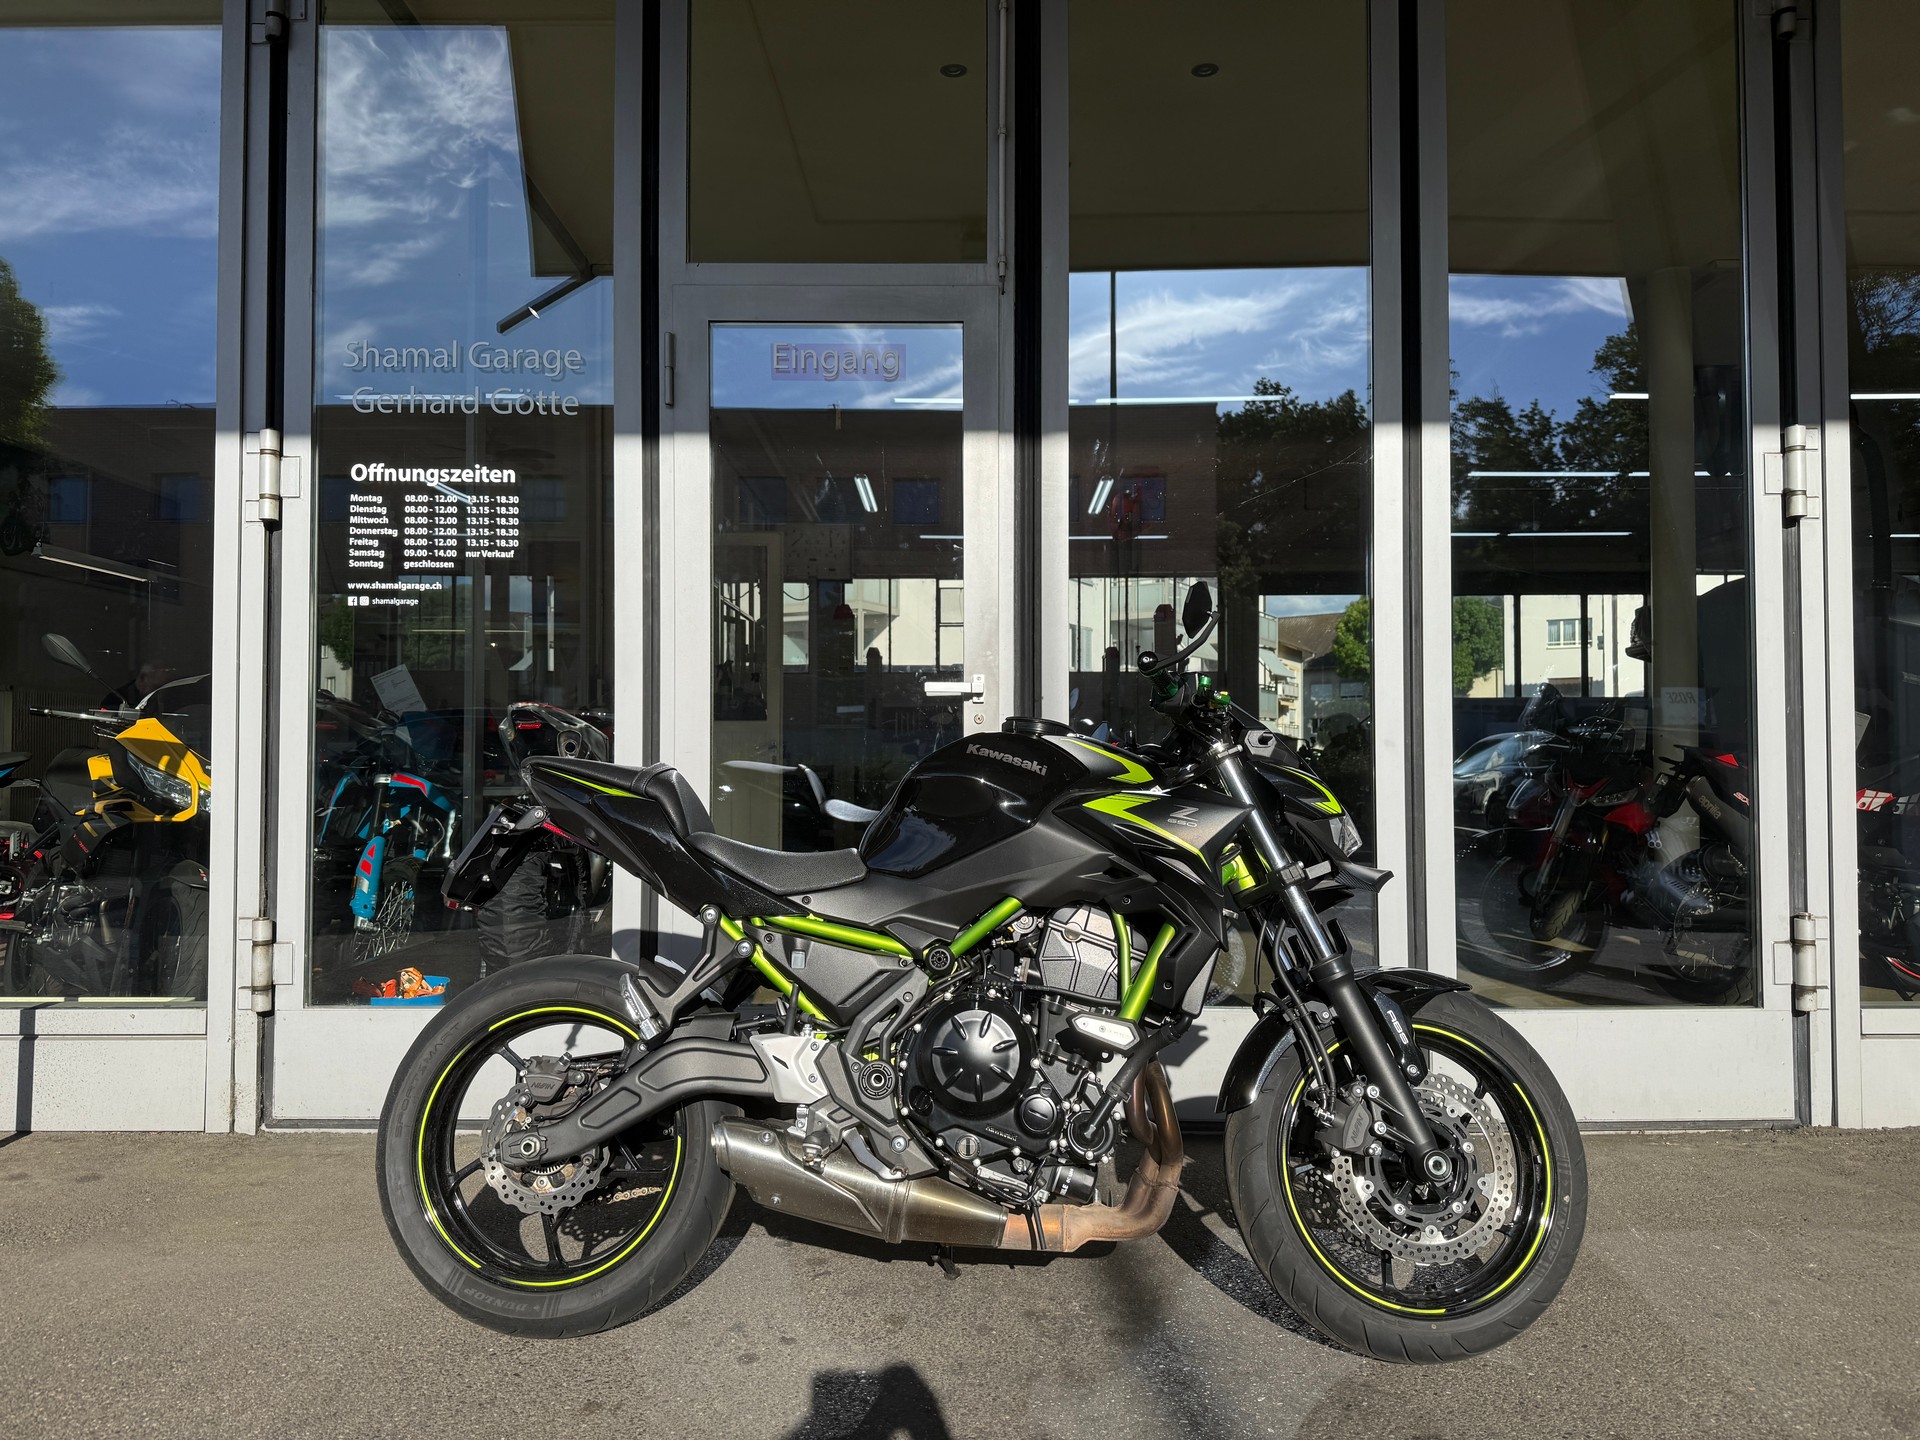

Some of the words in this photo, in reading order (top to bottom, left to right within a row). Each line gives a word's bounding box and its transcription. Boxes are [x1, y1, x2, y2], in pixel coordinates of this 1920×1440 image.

[343, 340, 457, 368] Shamal
[468, 341, 582, 376] Garage
[772, 343, 899, 378] Eingang
[352, 386, 479, 414] Gerhard
[490, 388, 579, 415] Götte
[350, 494, 383, 504] Montag
[350, 505, 387, 514] Dienstag
[350, 516, 389, 524] Mittwoch
[349, 527, 398, 537] Donnerstag
[349, 538, 379, 547] Freitag
[349, 549, 385, 558] Samstag
[482, 550, 515, 558] Verkauf
[349, 560, 384, 569] Sonntag
[404, 560, 454, 569] geschlossen
[348, 581, 442, 591] www.shamalgarage.ch
[372, 597, 419, 607] shamalgarage
[966, 743, 1048, 776] Kawasaki
[1699, 794, 1722, 819] aprilia
[1170, 803, 1199, 821] Z
[1167, 818, 1198, 828] 650
[1386, 1009, 1409, 1045] ABS
